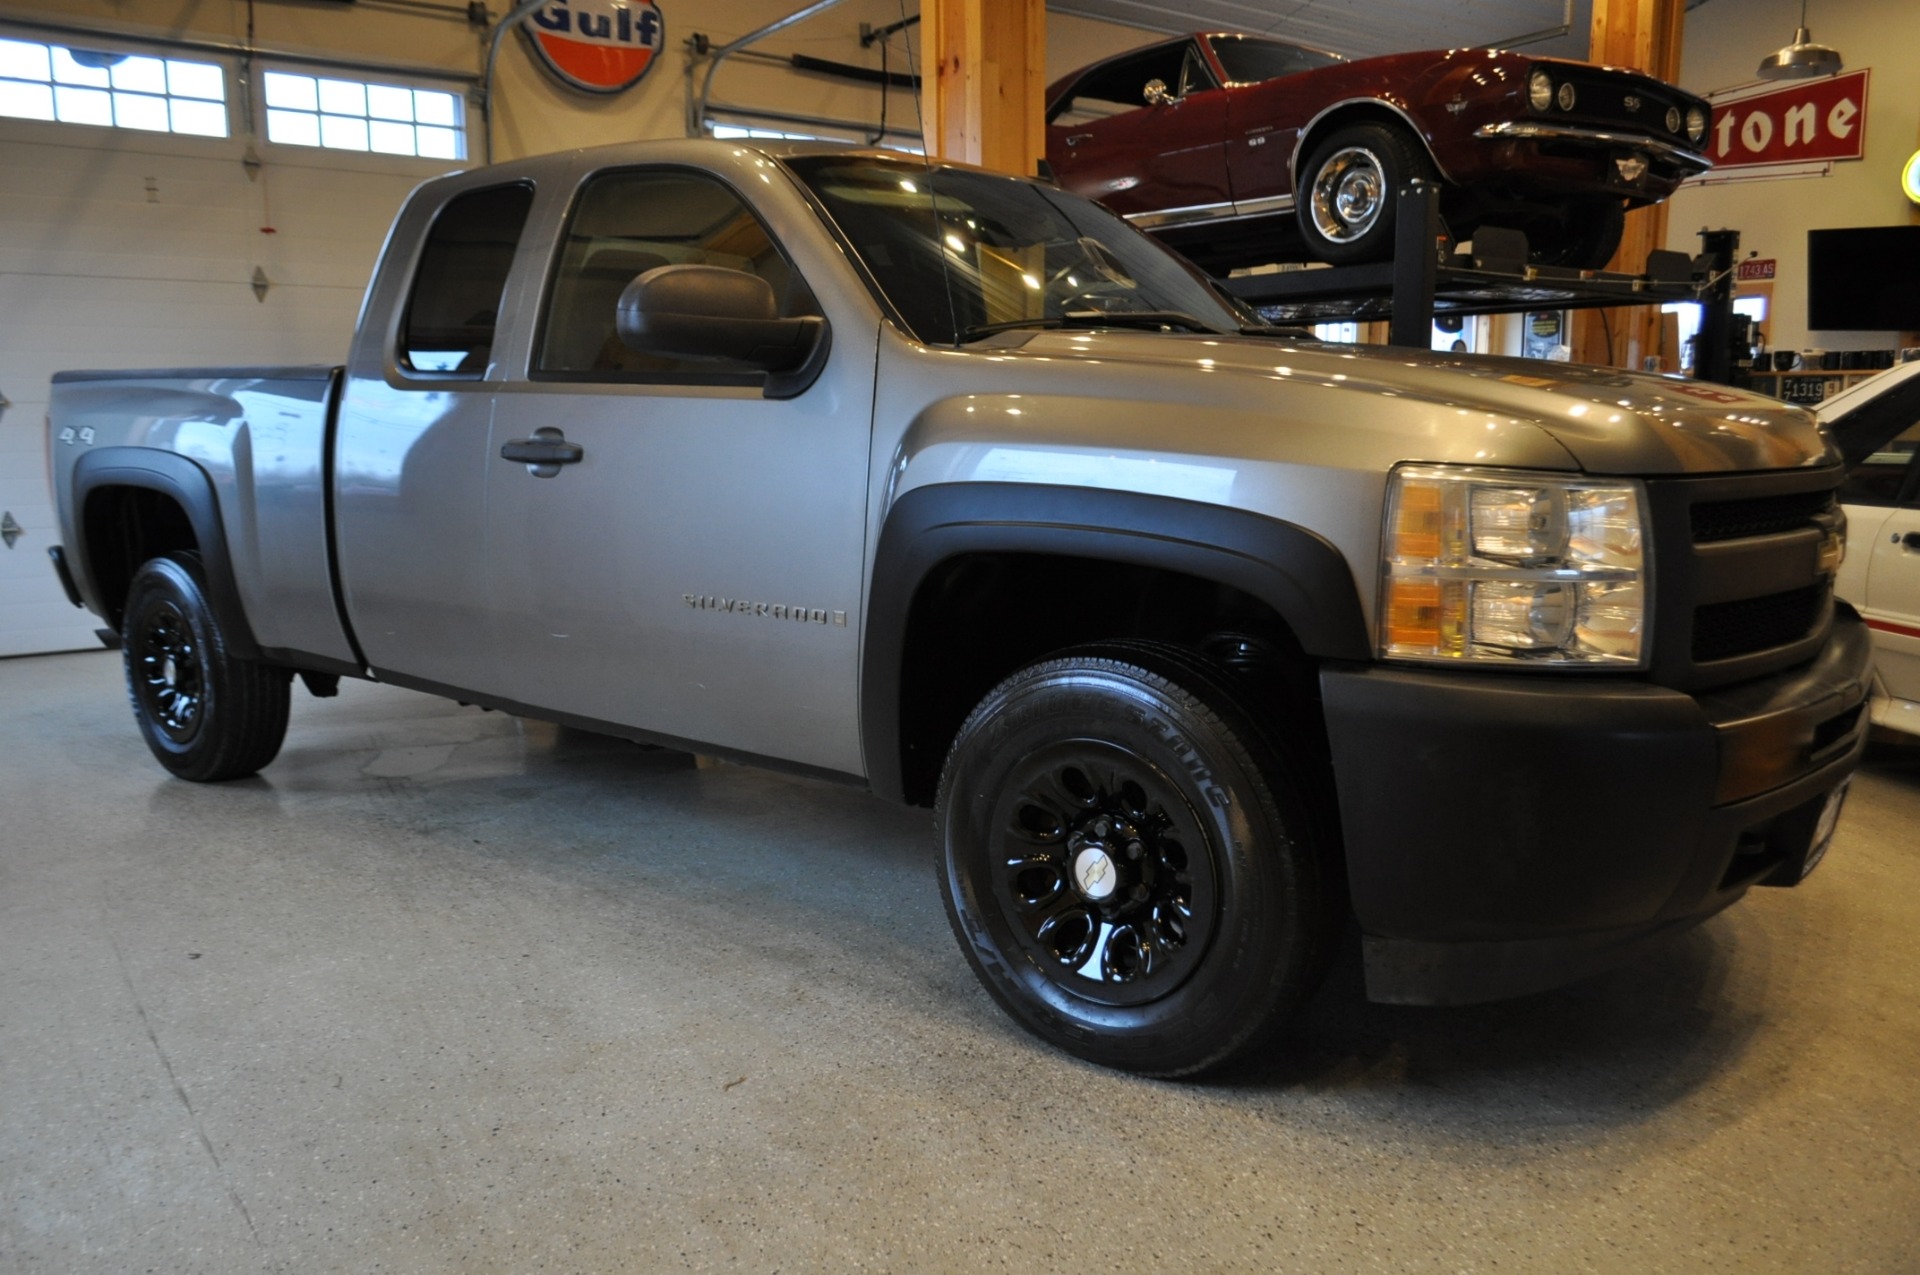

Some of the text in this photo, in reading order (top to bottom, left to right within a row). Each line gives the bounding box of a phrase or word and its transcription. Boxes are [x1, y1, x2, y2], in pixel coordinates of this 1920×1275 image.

[532, 0, 659, 45] Gulf
[1715, 97, 1857, 158] tone
[1792, 382, 1823, 397] 1319
[682, 592, 828, 625] SILVERADO
